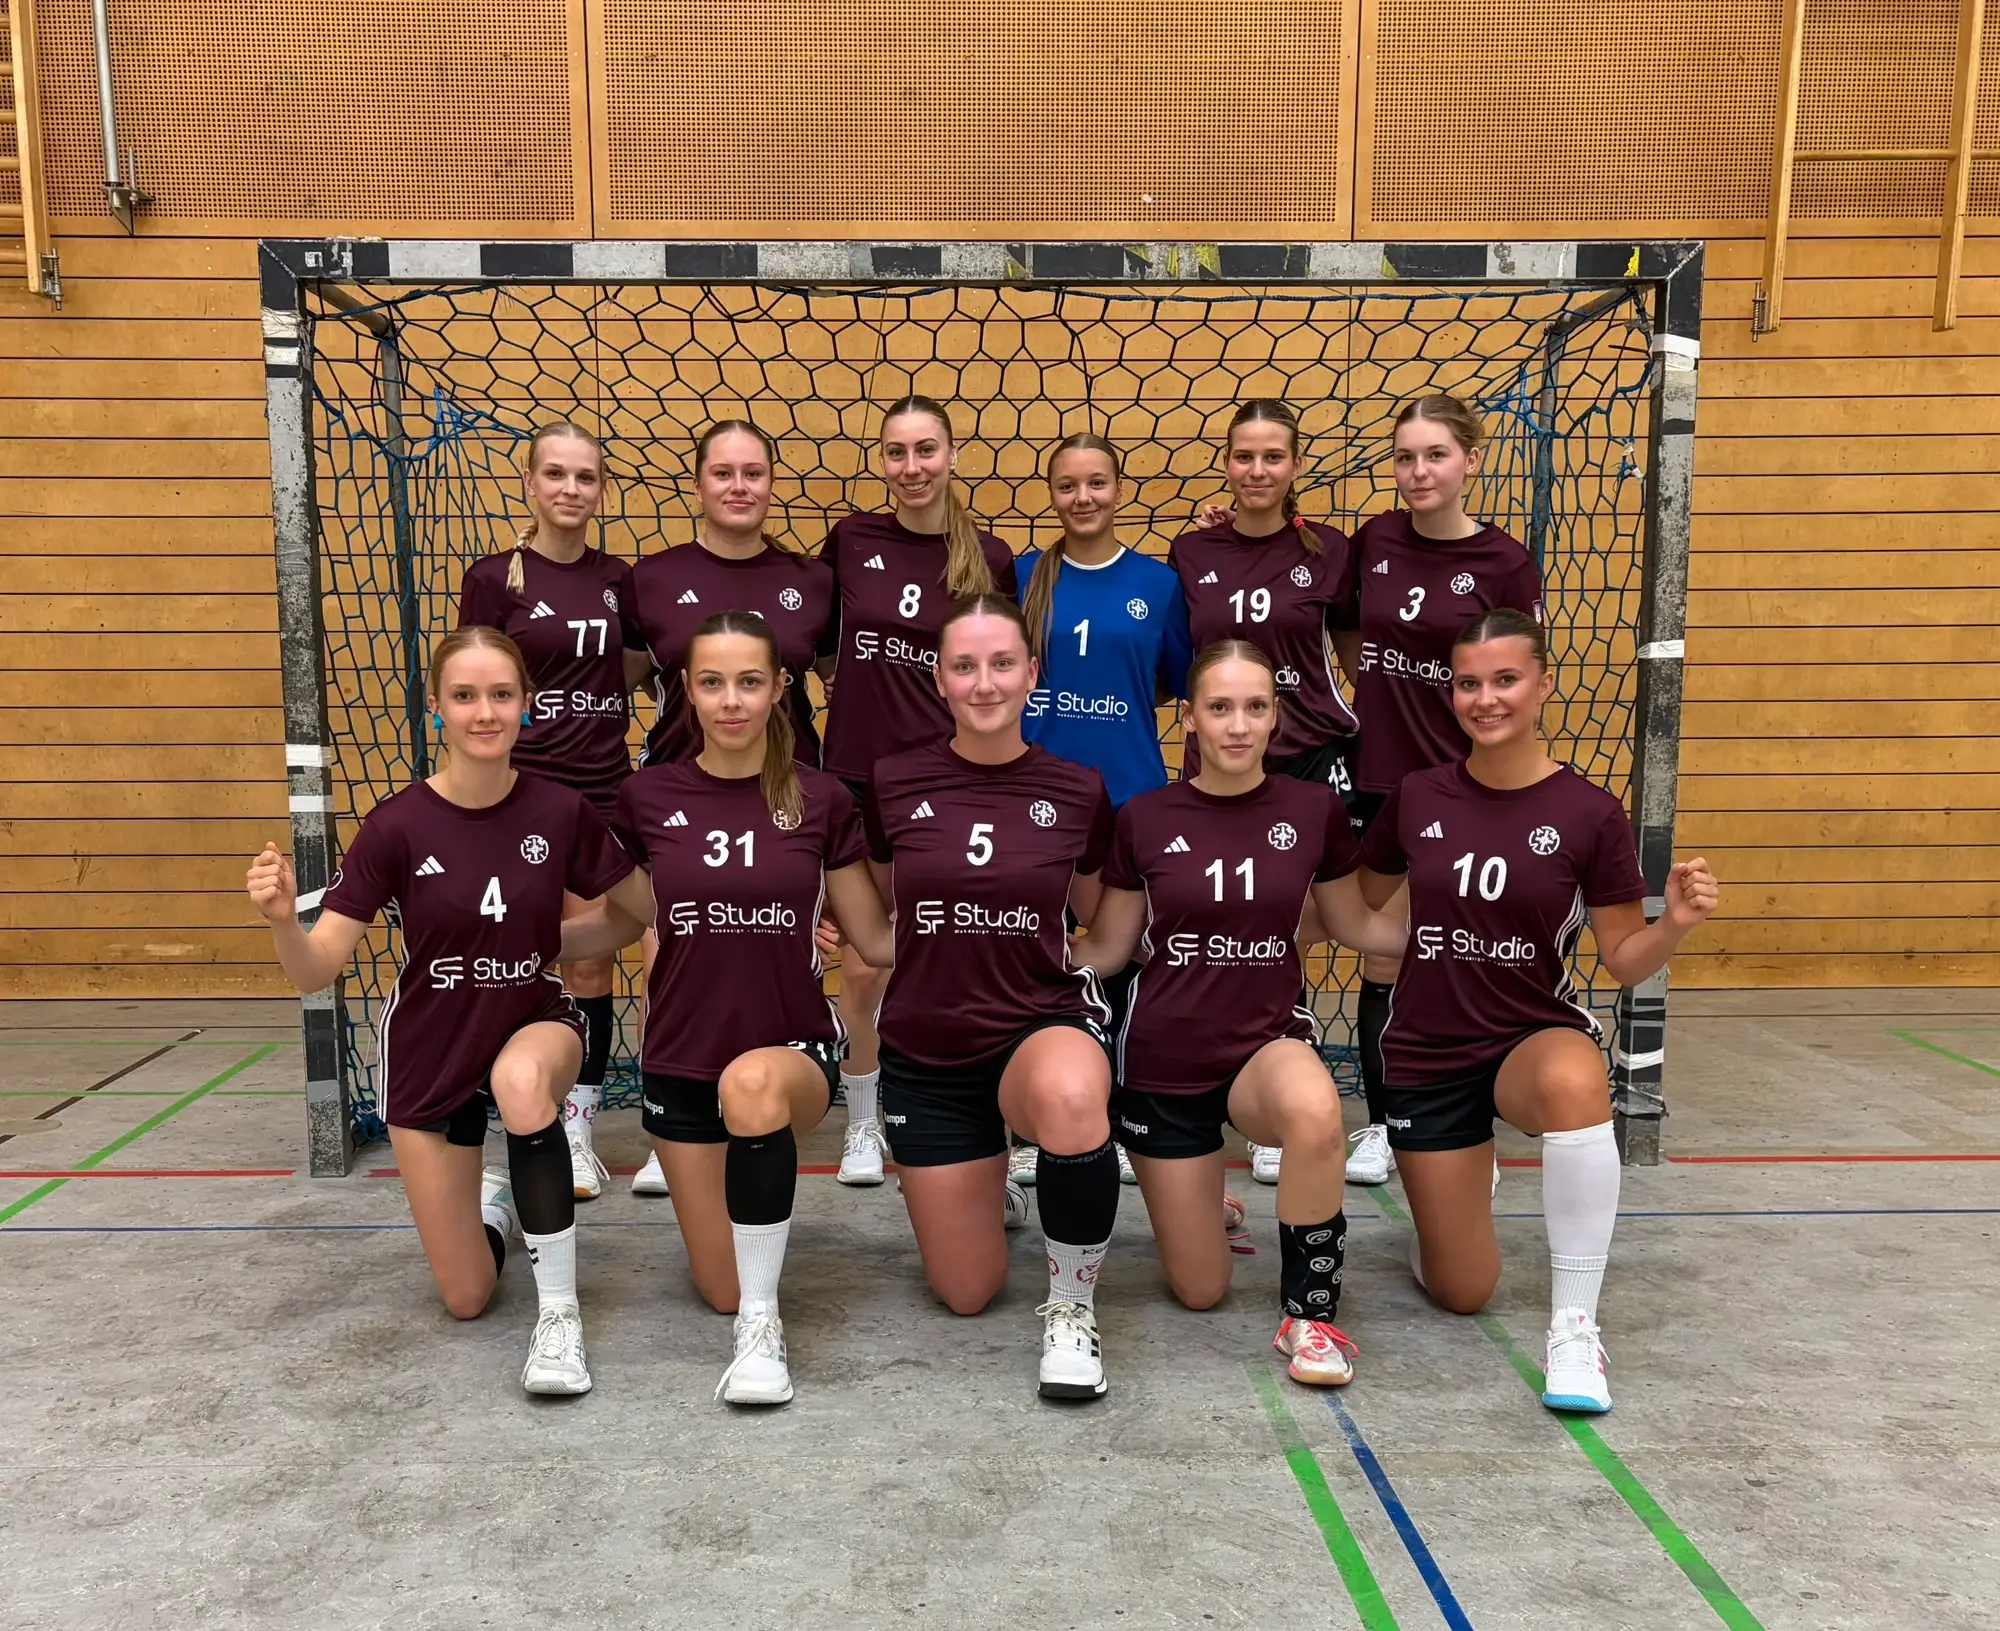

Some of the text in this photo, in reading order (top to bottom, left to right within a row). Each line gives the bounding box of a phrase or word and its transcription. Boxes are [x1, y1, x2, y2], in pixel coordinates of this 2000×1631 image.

[899, 584, 922, 618] 8
[1229, 588, 1271, 623] 19
[1400, 586, 1426, 622] 3
[567, 619, 608, 657] 77
[885, 637, 938, 666] Stud
[1073, 619, 1089, 656] 1
[1383, 649, 1453, 680] Studio
[1057, 692, 1128, 716] Studio
[703, 830, 755, 868] 31
[966, 823, 994, 866] 5
[1205, 857, 1255, 902] 11
[1452, 852, 1508, 901] 10
[480, 876, 508, 923] 4
[708, 902, 796, 927] Studio
[954, 902, 1040, 930] Studio
[1207, 935, 1286, 958] Studio
[1452, 929, 1535, 960] Studio
